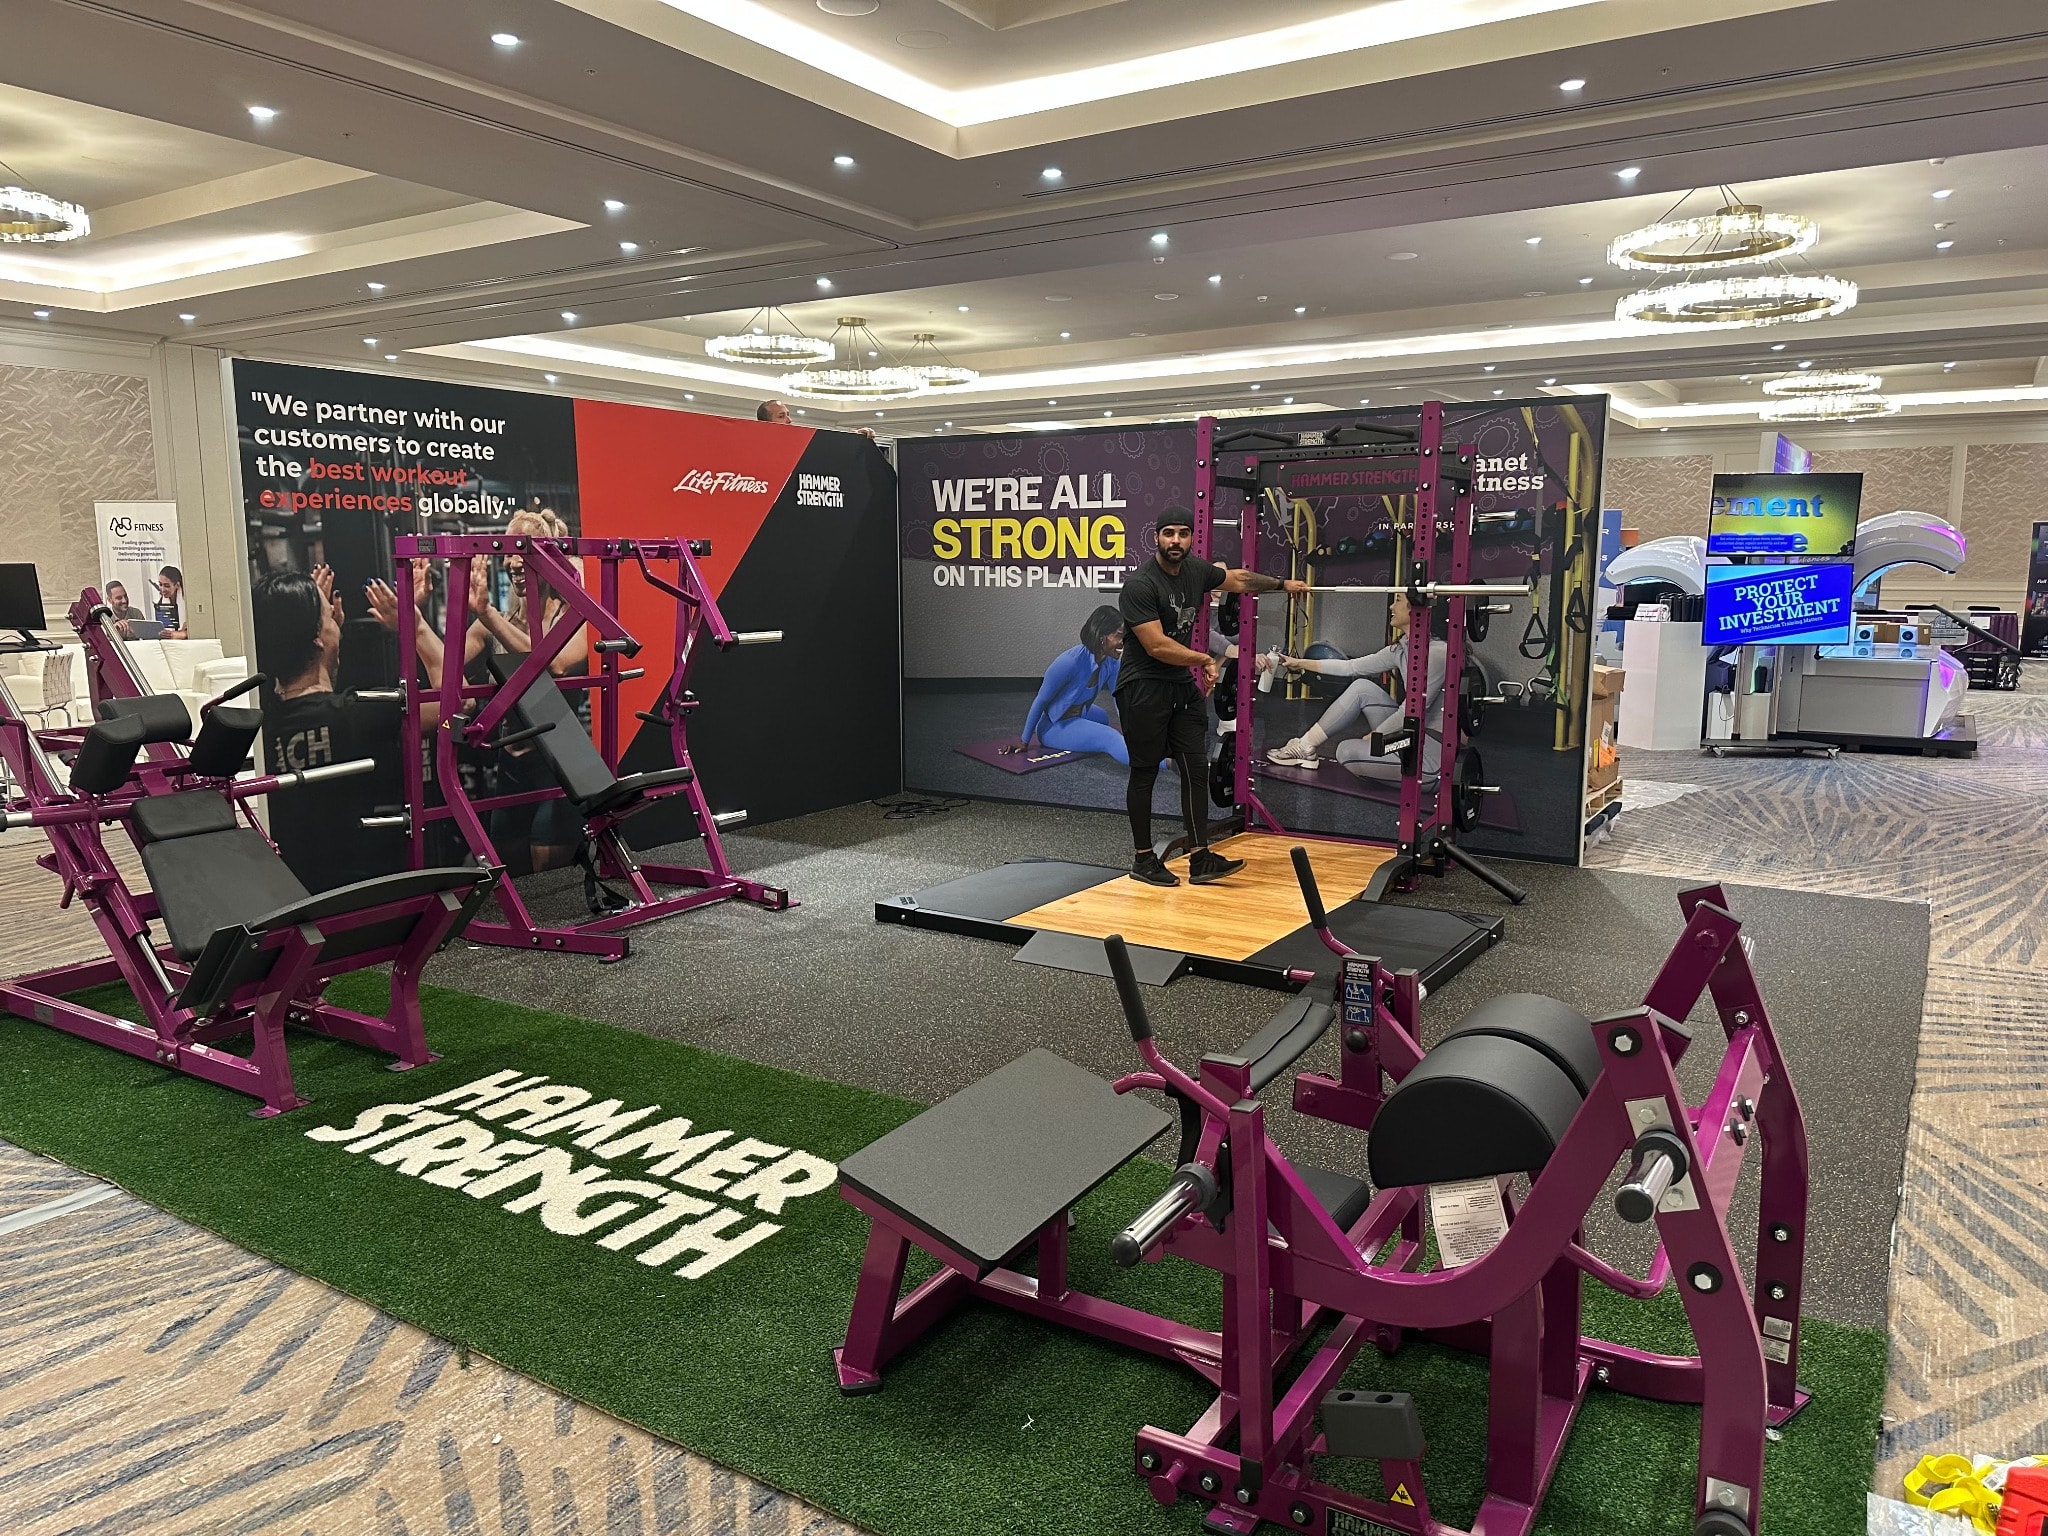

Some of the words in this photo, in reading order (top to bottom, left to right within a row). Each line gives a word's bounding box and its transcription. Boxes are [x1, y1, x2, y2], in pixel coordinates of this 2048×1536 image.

[316, 402, 407, 426] partner
[414, 407, 464, 431] with
[470, 416, 506, 435] our
[254, 428, 391, 453] customers
[396, 435, 421, 455] to
[427, 441, 495, 461] create
[256, 454, 302, 477] the
[309, 457, 365, 481] best
[370, 463, 468, 487] workout
[1476, 452, 1529, 473] anet
[799, 473, 841, 492] HAMMER
[1291, 472, 1349, 488] HAMMER
[1351, 468, 1418, 485] STRENGTH
[1477, 474, 1545, 492] tness
[259, 487, 412, 513] experiences
[797, 489, 844, 508] STRENGTH
[1050, 473, 1127, 510] ALL
[134, 523, 164, 532] FITNESS
[933, 514, 1126, 560] STRONG
[933, 565, 965, 587] ON
[969, 565, 1022, 588] THIS
[1734, 574, 1819, 601] PROTECT
[1718, 598, 1841, 630] INVESTMENT
[1752, 591, 1804, 611] YOUR
[420, 1069, 838, 1215] HAMMER
[304, 1103, 786, 1280] STRENGTH
